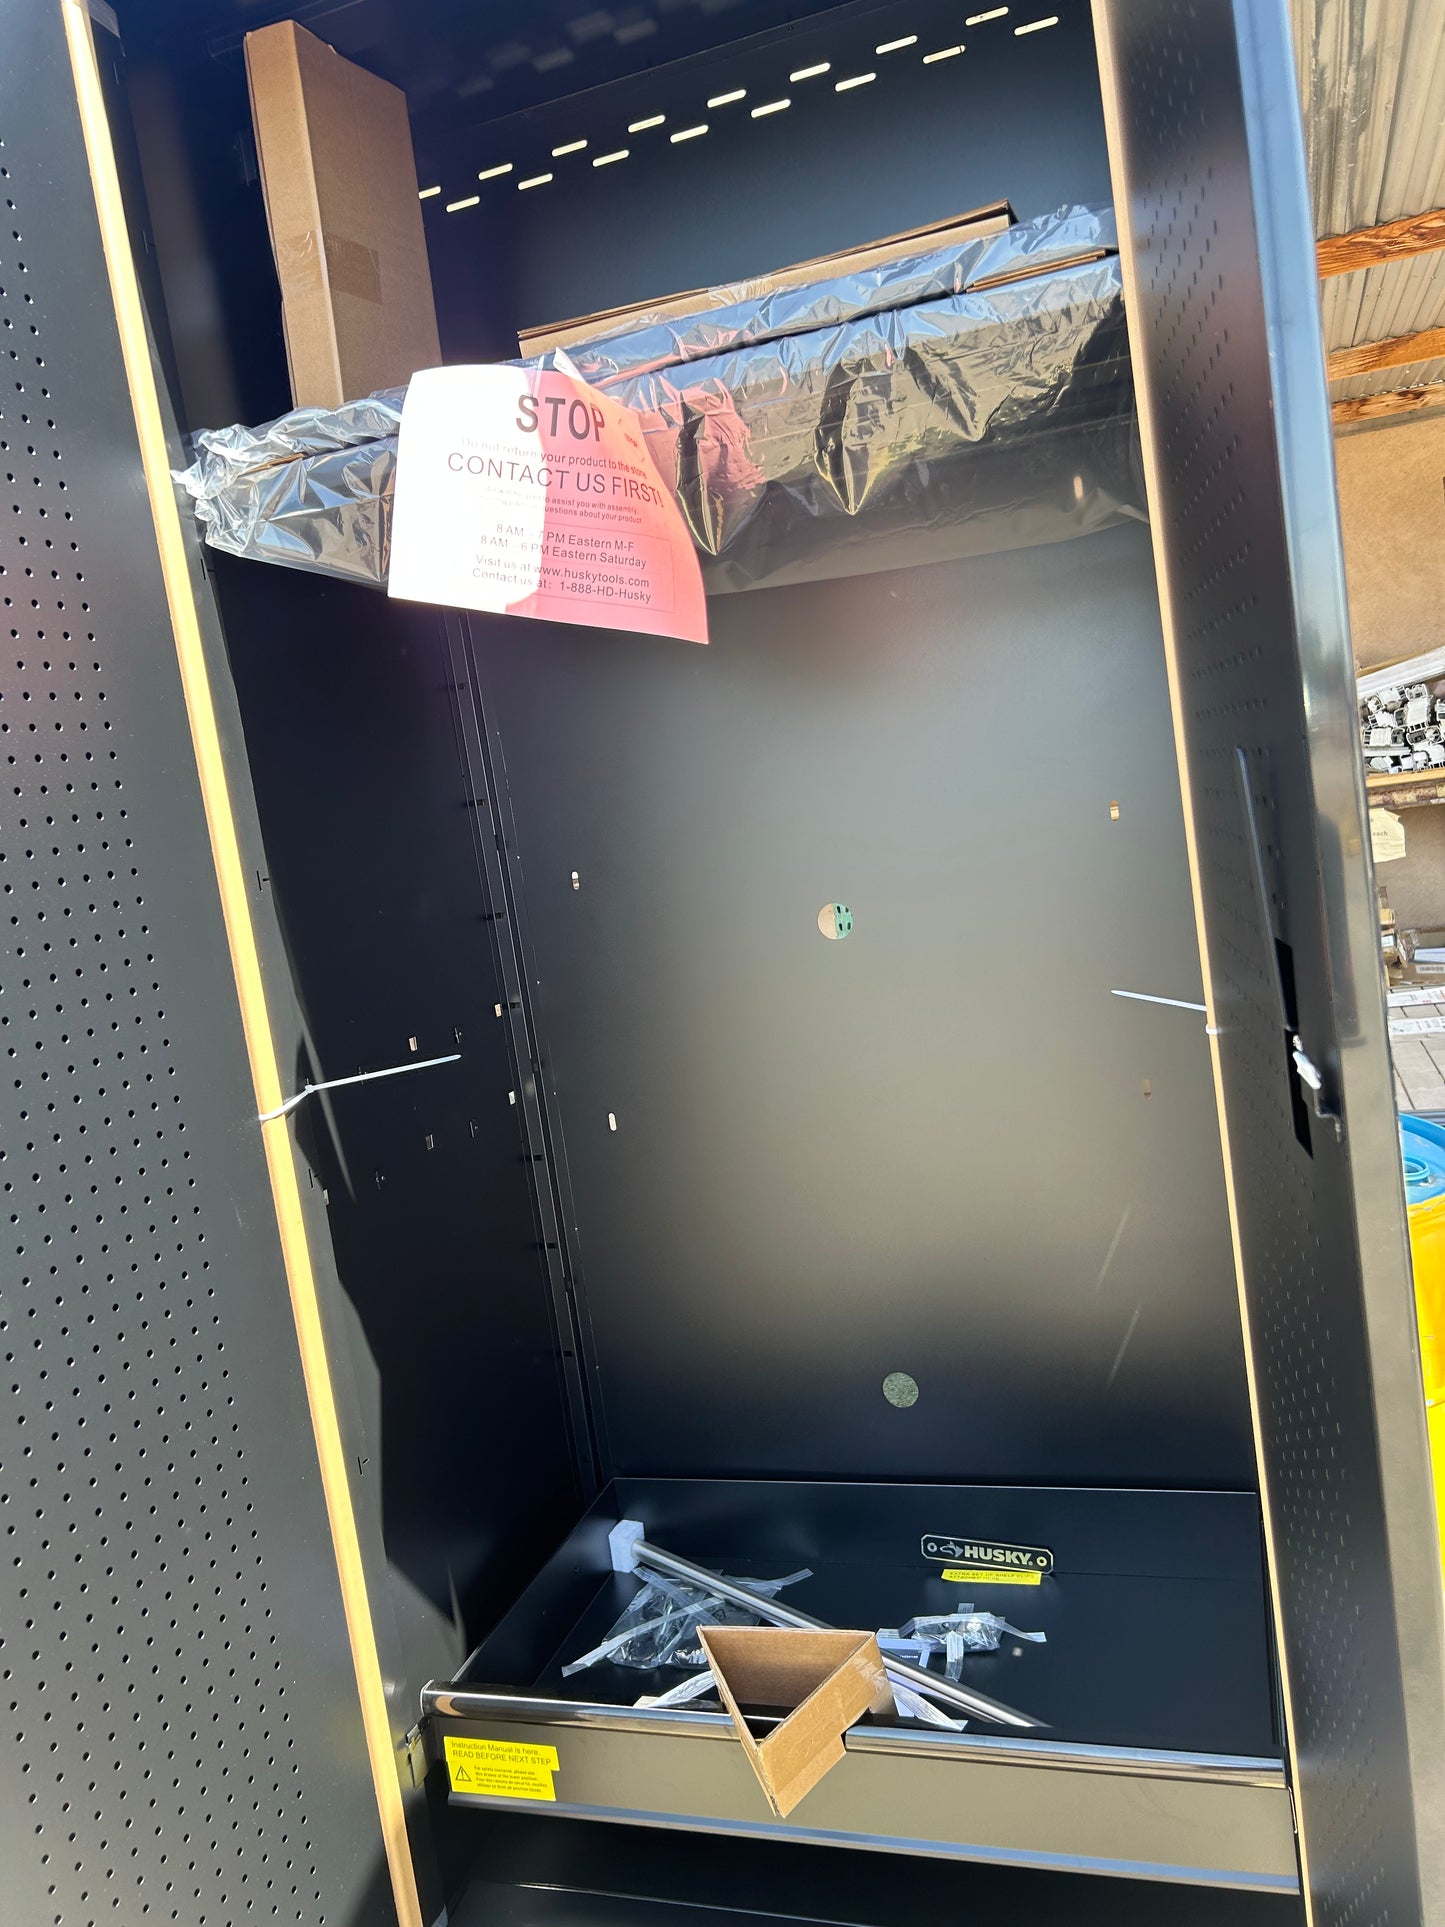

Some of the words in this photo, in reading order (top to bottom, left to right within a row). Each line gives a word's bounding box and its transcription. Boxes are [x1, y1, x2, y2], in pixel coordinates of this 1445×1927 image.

[516, 394, 605, 442] STOP
[461, 437, 478, 448] Do
[482, 442, 500, 452] not
[503, 446, 537, 458] return
[540, 452, 566, 465] your
[569, 456, 607, 468] product
[609, 460, 617, 470] to
[618, 461, 630, 473] the
[448, 453, 570, 490] CONTACT
[576, 472, 606, 493] US
[612, 476, 664, 508] FIRST!
[540, 505, 578, 516] questions
[580, 509, 600, 519] about
[601, 511, 618, 522] your
[618, 514, 642, 524] product
[552, 497, 575, 506] assist
[576, 499, 590, 508] you
[591, 501, 606, 510] with
[480, 535, 487, 545] 8
[490, 536, 508, 548] AM
[531, 543, 549, 555] PM
[552, 546, 597, 561] Eastern
[600, 552, 647, 570] Saturday
[496, 523, 503, 533] 8
[506, 525, 524, 537] AM
[547, 531, 565, 544] PM
[568, 534, 612, 549] Eastern
[614, 540, 634, 551] M-F
[472, 567, 517, 584] Contact
[520, 577, 533, 586] us
[560, 581, 651, 604] 1-888-HD-Husky
[476, 553, 501, 567] Visit
[504, 561, 517, 569] us
[520, 563, 531, 572] at
[534, 565, 650, 588] www.huskytools.com
[451, 1741, 486, 1751] Instruction
[488, 1744, 513, 1754] Manual
[453, 1750, 474, 1759] READ
[476, 1752, 508, 1762] BEFORE
[509, 1755, 528, 1764] NEXT
[531, 1758, 552, 1766] STEP
